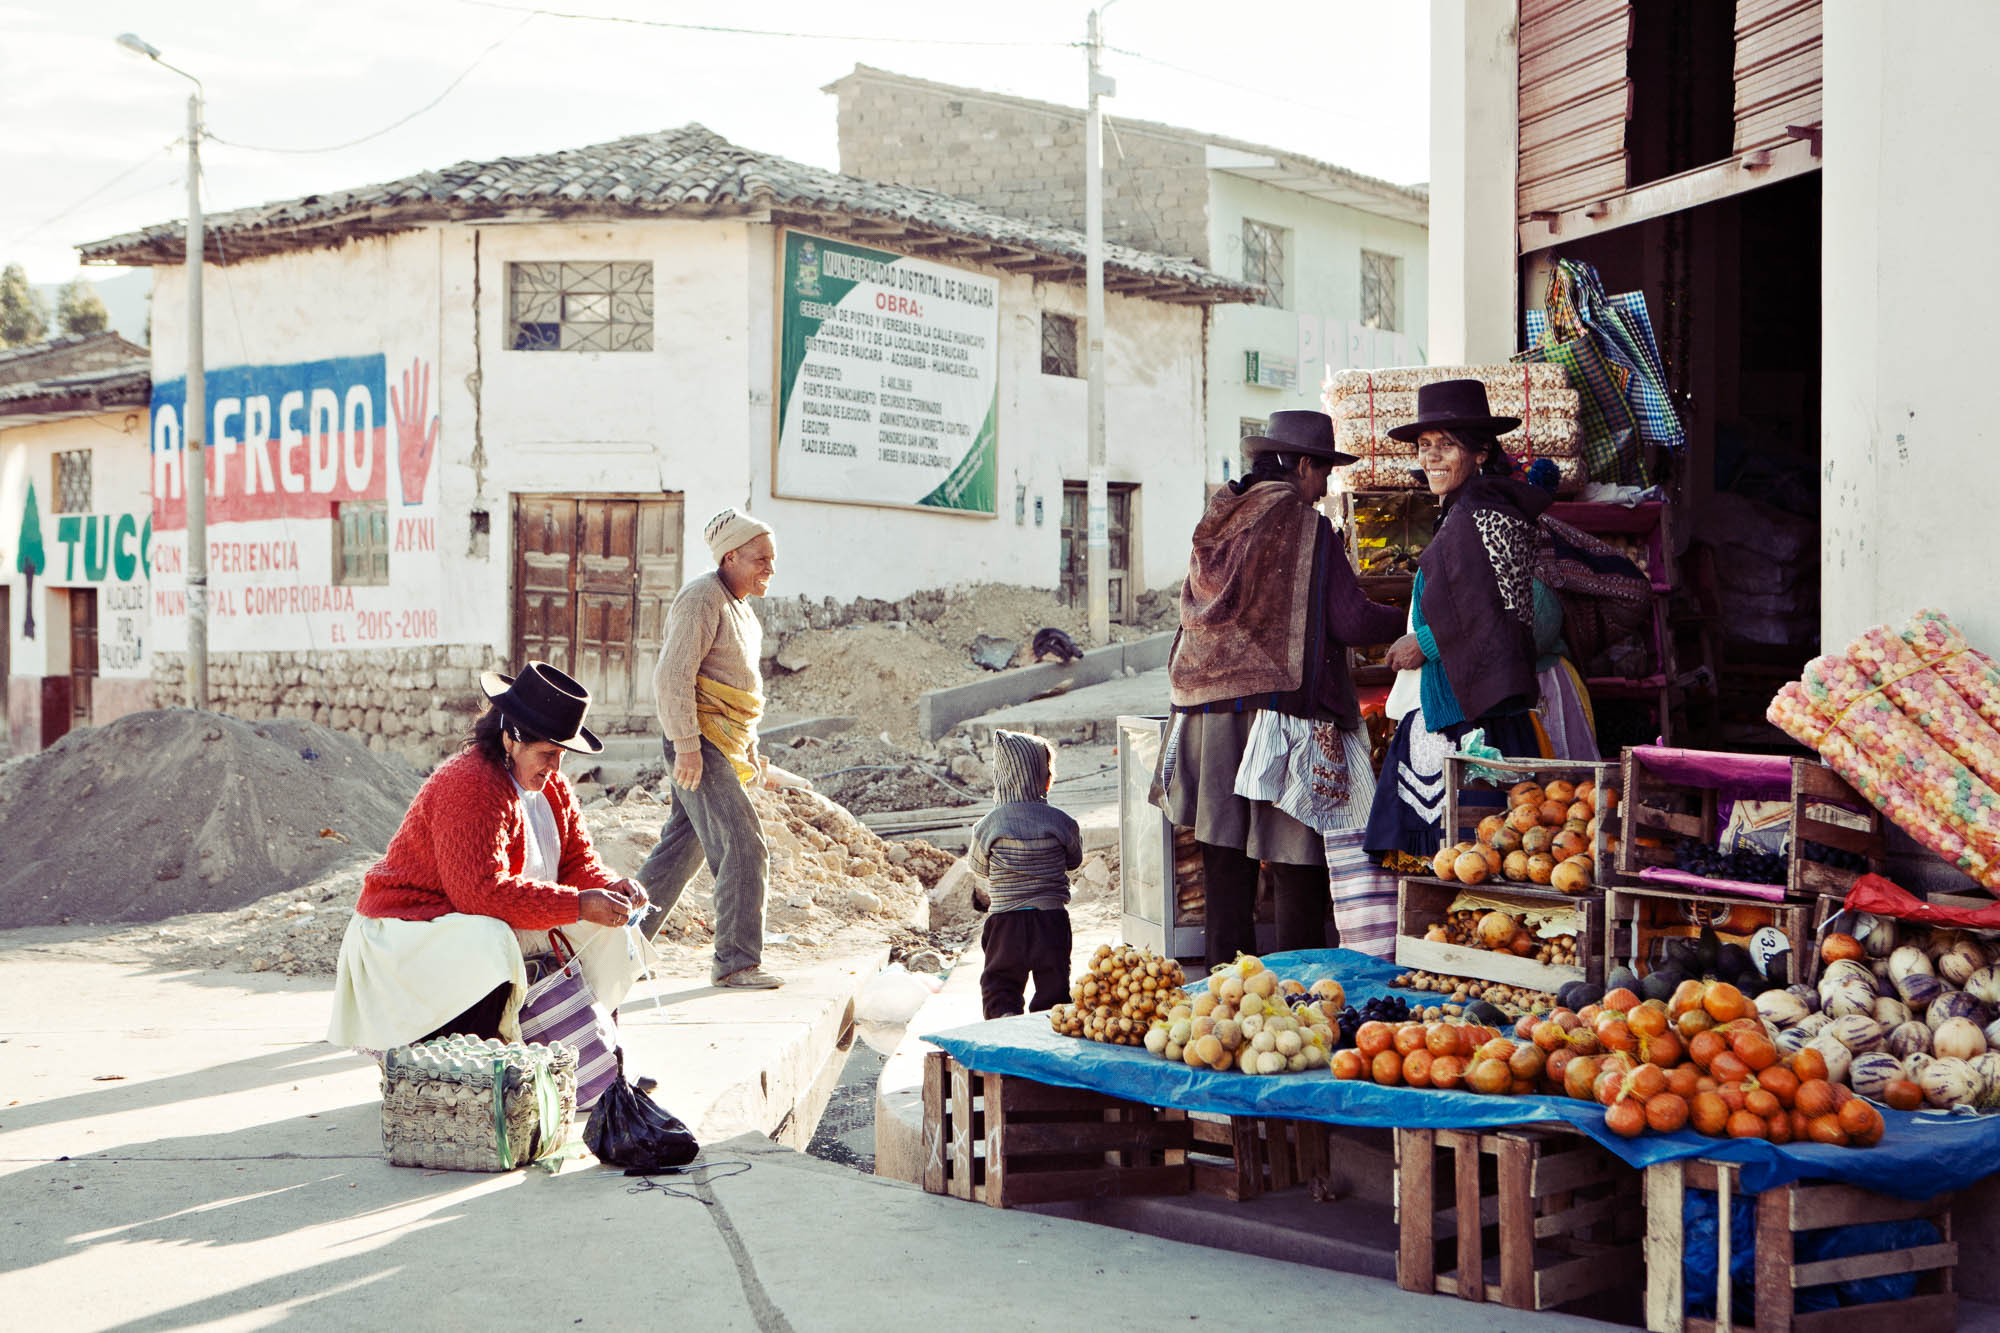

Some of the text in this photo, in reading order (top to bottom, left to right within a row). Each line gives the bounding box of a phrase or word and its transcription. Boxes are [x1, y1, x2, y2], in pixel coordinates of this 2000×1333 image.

[823, 252, 993, 308] MUNICIPALIDAD DISTRITAL DE PAUCARA
[875, 291, 923, 318] OBRA:
[838, 308, 847, 323] DE
[850, 310, 873, 327] PISTAS
[875, 315, 880, 329] Y
[882, 316, 910, 334] VEREDAS
[913, 322, 921, 336] EN
[923, 324, 931, 338] LA
[933, 326, 952, 342] CALLE
[805, 336, 838, 354] DISTRITO
[839, 342, 849, 356] DE
[851, 344, 882, 362] PAUCARA
[891, 351, 926, 369] ACOBAMBA
[932, 358, 978, 377] HUANCAVELICA
[820, 323, 968, 360] CUADRAS 1 Y 2 DE LA LOCALIDAD DE PAUCARA
[803, 382, 823, 398] FUENTE
[394, 517, 435, 552] AYNI
[155, 543, 181, 573] CON
[155, 585, 355, 616] MUNPAL COMPROBADA
[332, 623, 346, 643] EL
